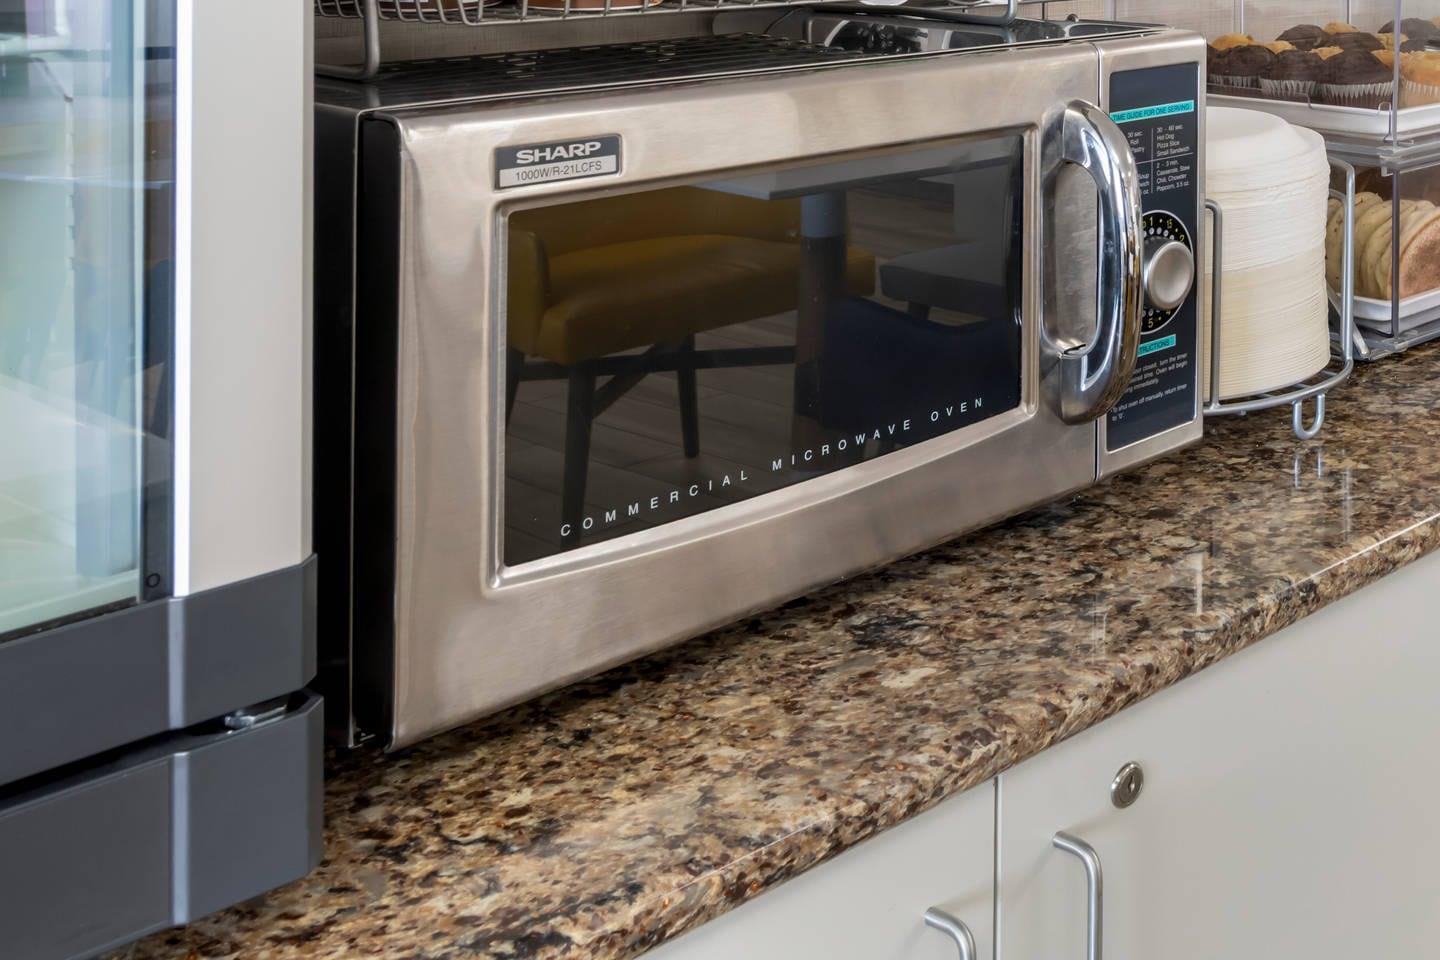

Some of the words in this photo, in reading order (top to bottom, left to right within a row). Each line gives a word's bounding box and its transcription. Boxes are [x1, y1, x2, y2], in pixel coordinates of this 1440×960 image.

[515, 141, 602, 165] SHARP
[515, 160, 603, 182] 1000W/R-21LCFS
[560, 470, 748, 536] COMMERCIAL
[772, 419, 911, 472] MICROWAVE
[930, 397, 983, 422] OVEN
